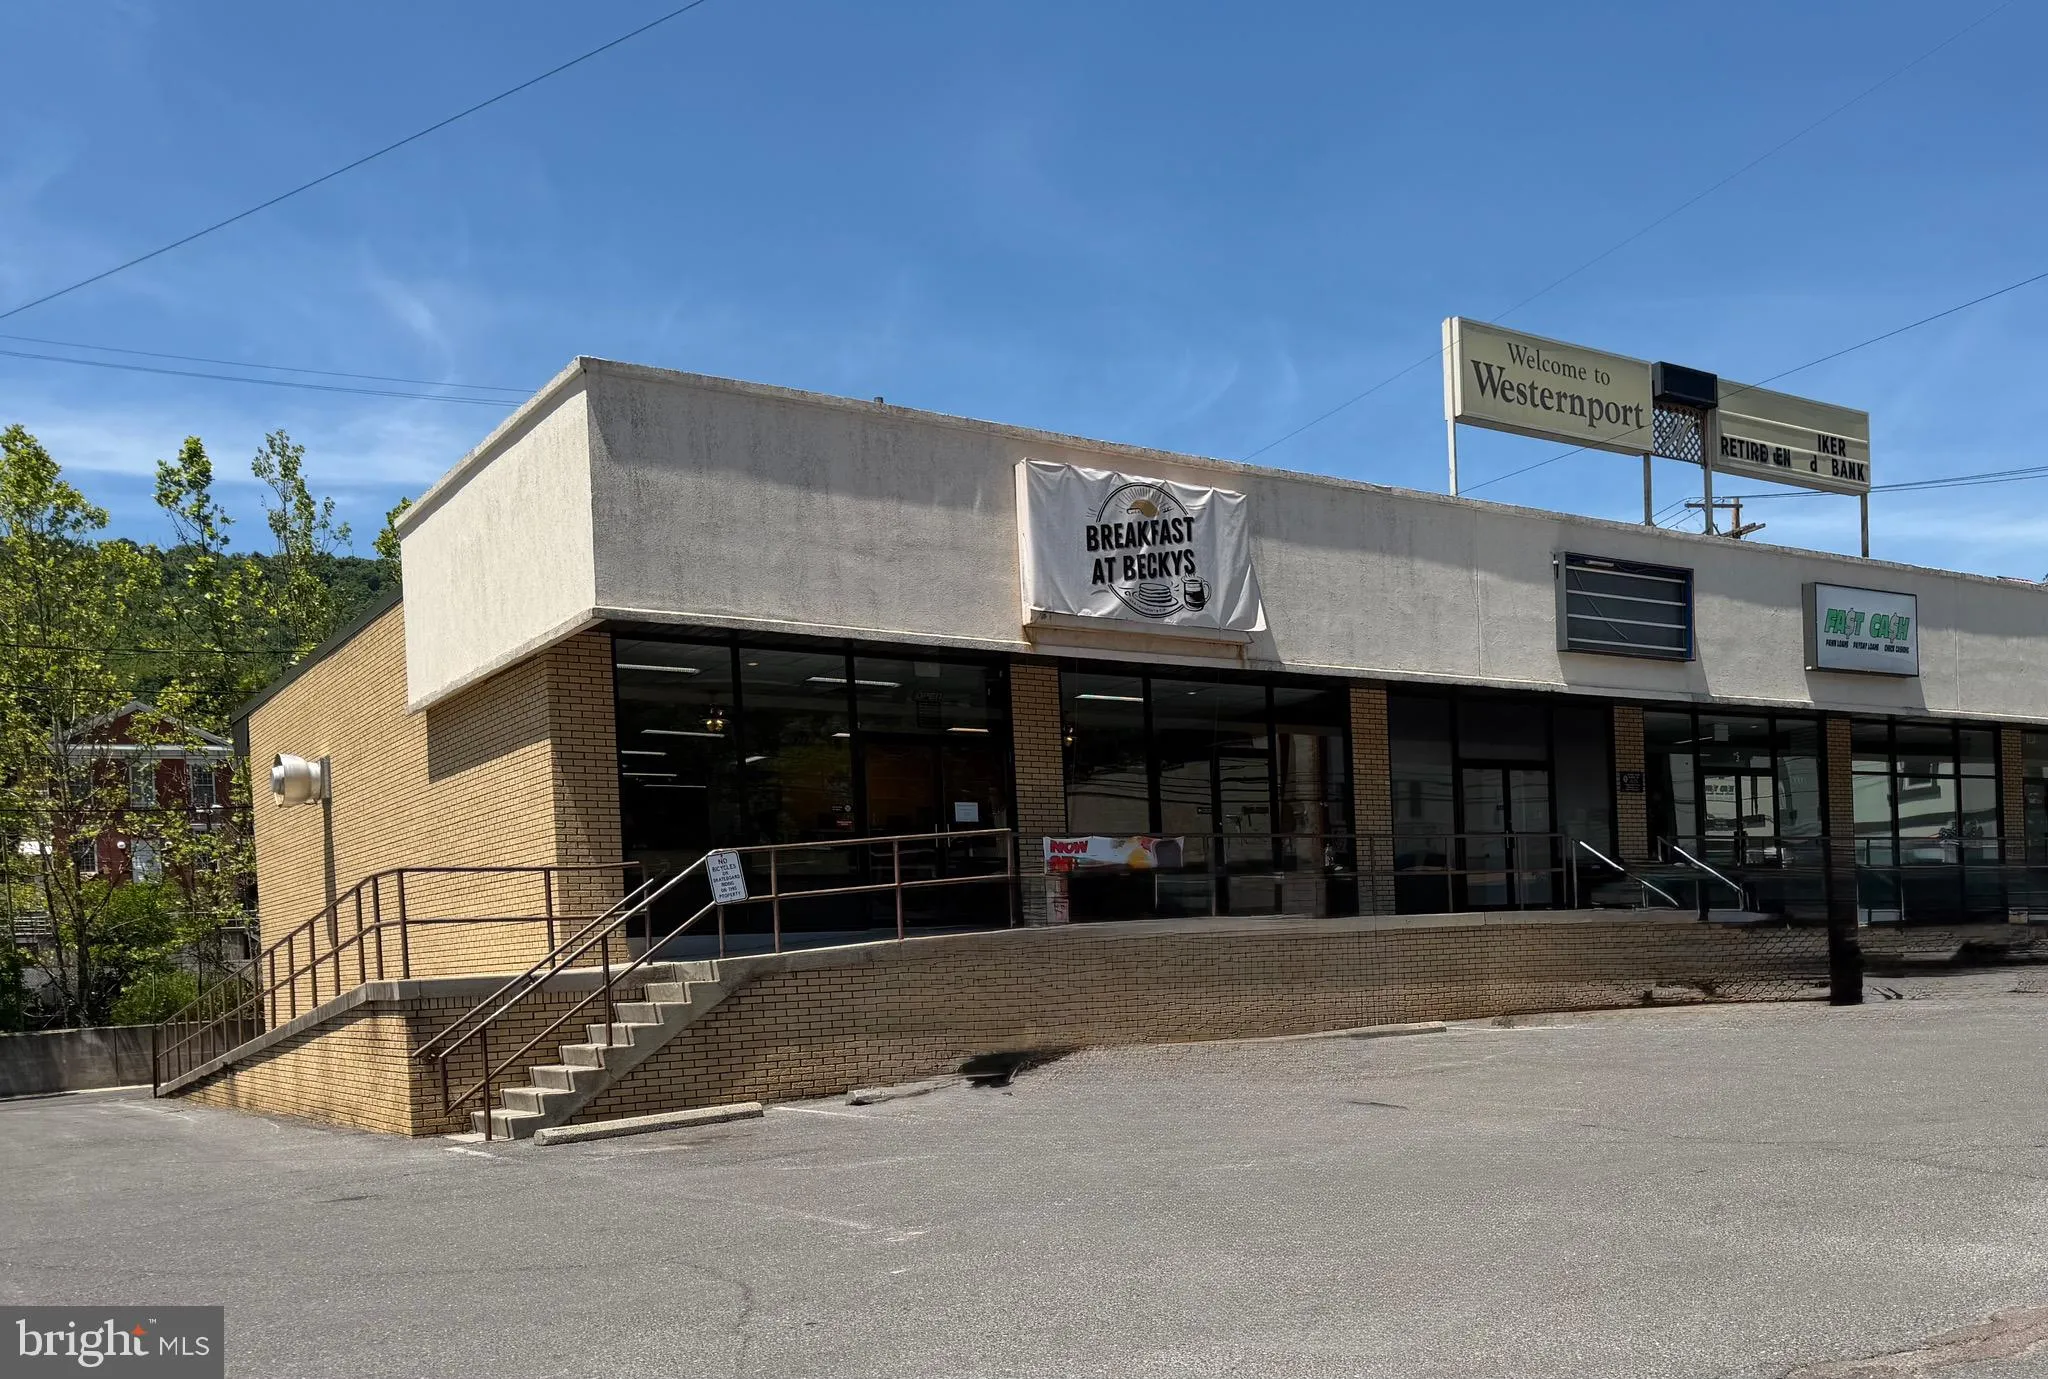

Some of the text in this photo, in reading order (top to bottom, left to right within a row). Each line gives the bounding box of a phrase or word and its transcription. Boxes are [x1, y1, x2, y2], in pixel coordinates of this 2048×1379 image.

[1506, 342, 1611, 386] Welcome to
[1470, 359, 1644, 429] Westernport
[1817, 434, 1846, 457] IKER
[1831, 459, 1865, 482] BANK
[1086, 516, 1195, 552] BREAKFAST
[1092, 549, 1196, 585] AT BECKYS
[1050, 840, 1089, 854] NOW
[712, 863, 736, 872] BICYCLES
